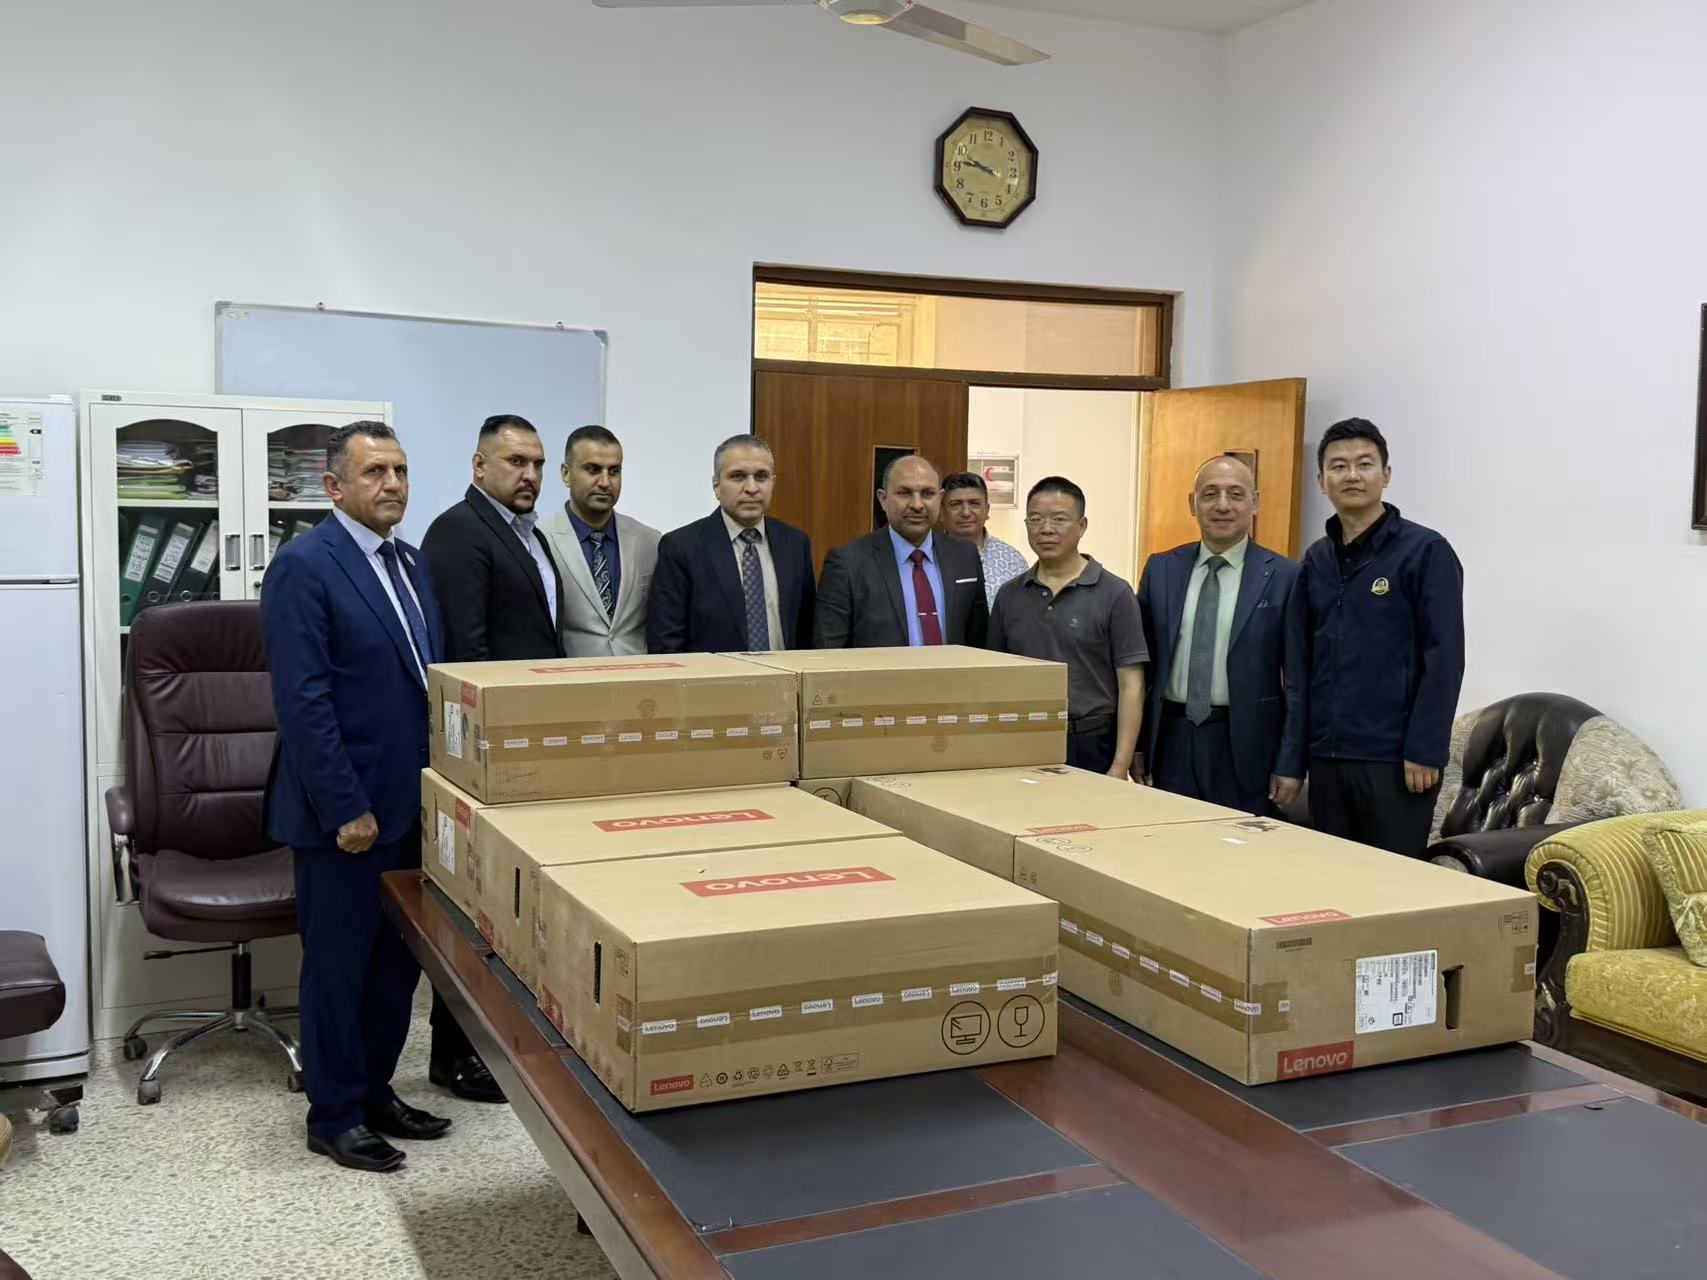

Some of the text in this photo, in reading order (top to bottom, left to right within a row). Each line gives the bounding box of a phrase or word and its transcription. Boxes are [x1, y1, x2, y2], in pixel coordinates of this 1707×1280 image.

[970, 133, 977, 144] 11
[984, 130, 993, 142] 12
[958, 145, 967, 156] 10
[1008, 151, 1015, 162] 2
[953, 161, 961, 172] 9
[1010, 168, 1017, 178] 3
[956, 178, 964, 189] 8
[966, 192, 974, 203] 7
[994, 195, 1002, 206] 5
[980, 198, 988, 209] 6
[612, 811, 758, 828] Lenovo
[704, 871, 876, 891] Lenovo
[1269, 911, 1339, 924] Lenovo
[699, 1014, 729, 1025] Lenovo
[751, 1008, 780, 1019] Lenovo
[803, 1001, 832, 1012] Lenovo
[1283, 1051, 1348, 1074] Lenovo
[653, 1079, 691, 1092] Lenovo
